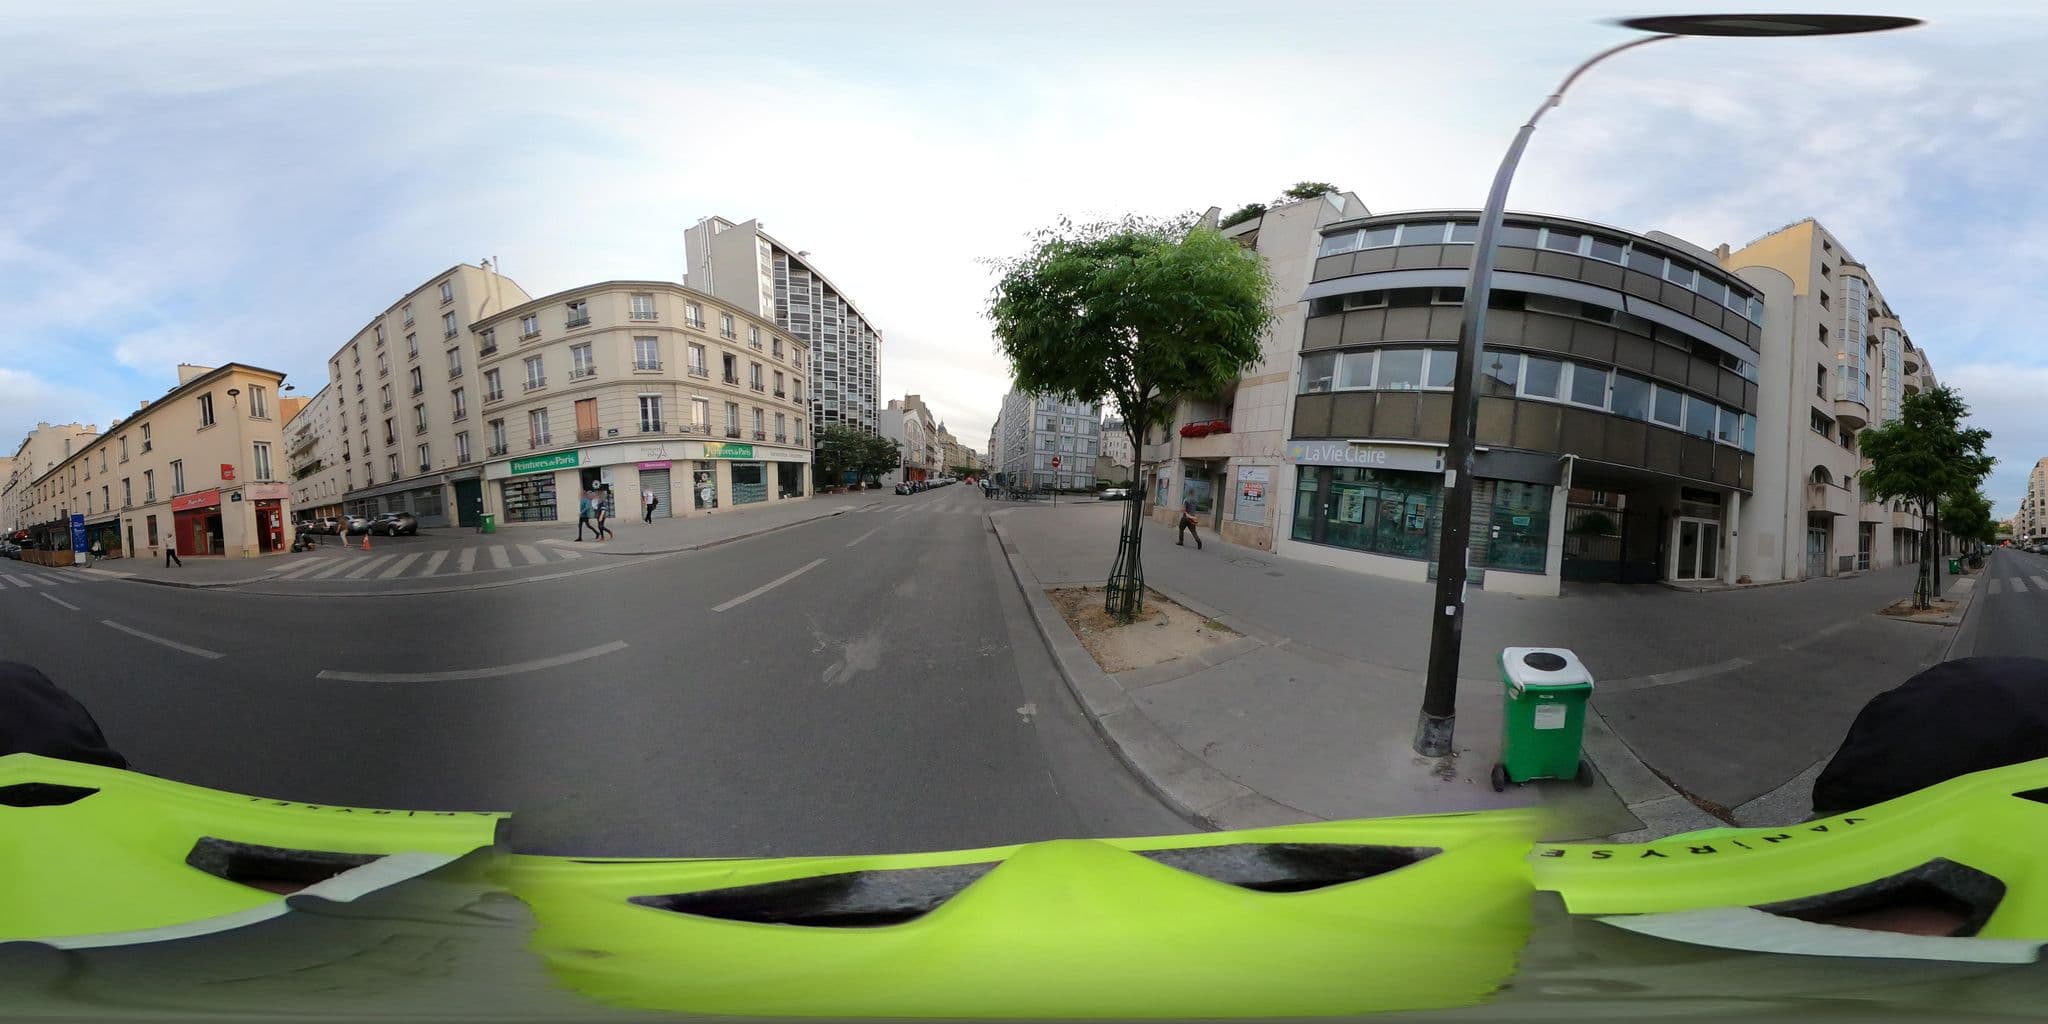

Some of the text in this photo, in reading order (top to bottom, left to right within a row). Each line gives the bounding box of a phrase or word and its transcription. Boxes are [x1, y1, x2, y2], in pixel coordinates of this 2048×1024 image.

[514, 461, 548, 471] Peintures
[555, 455, 575, 465] Paris
[1305, 445, 1386, 464] La Vie Claire
